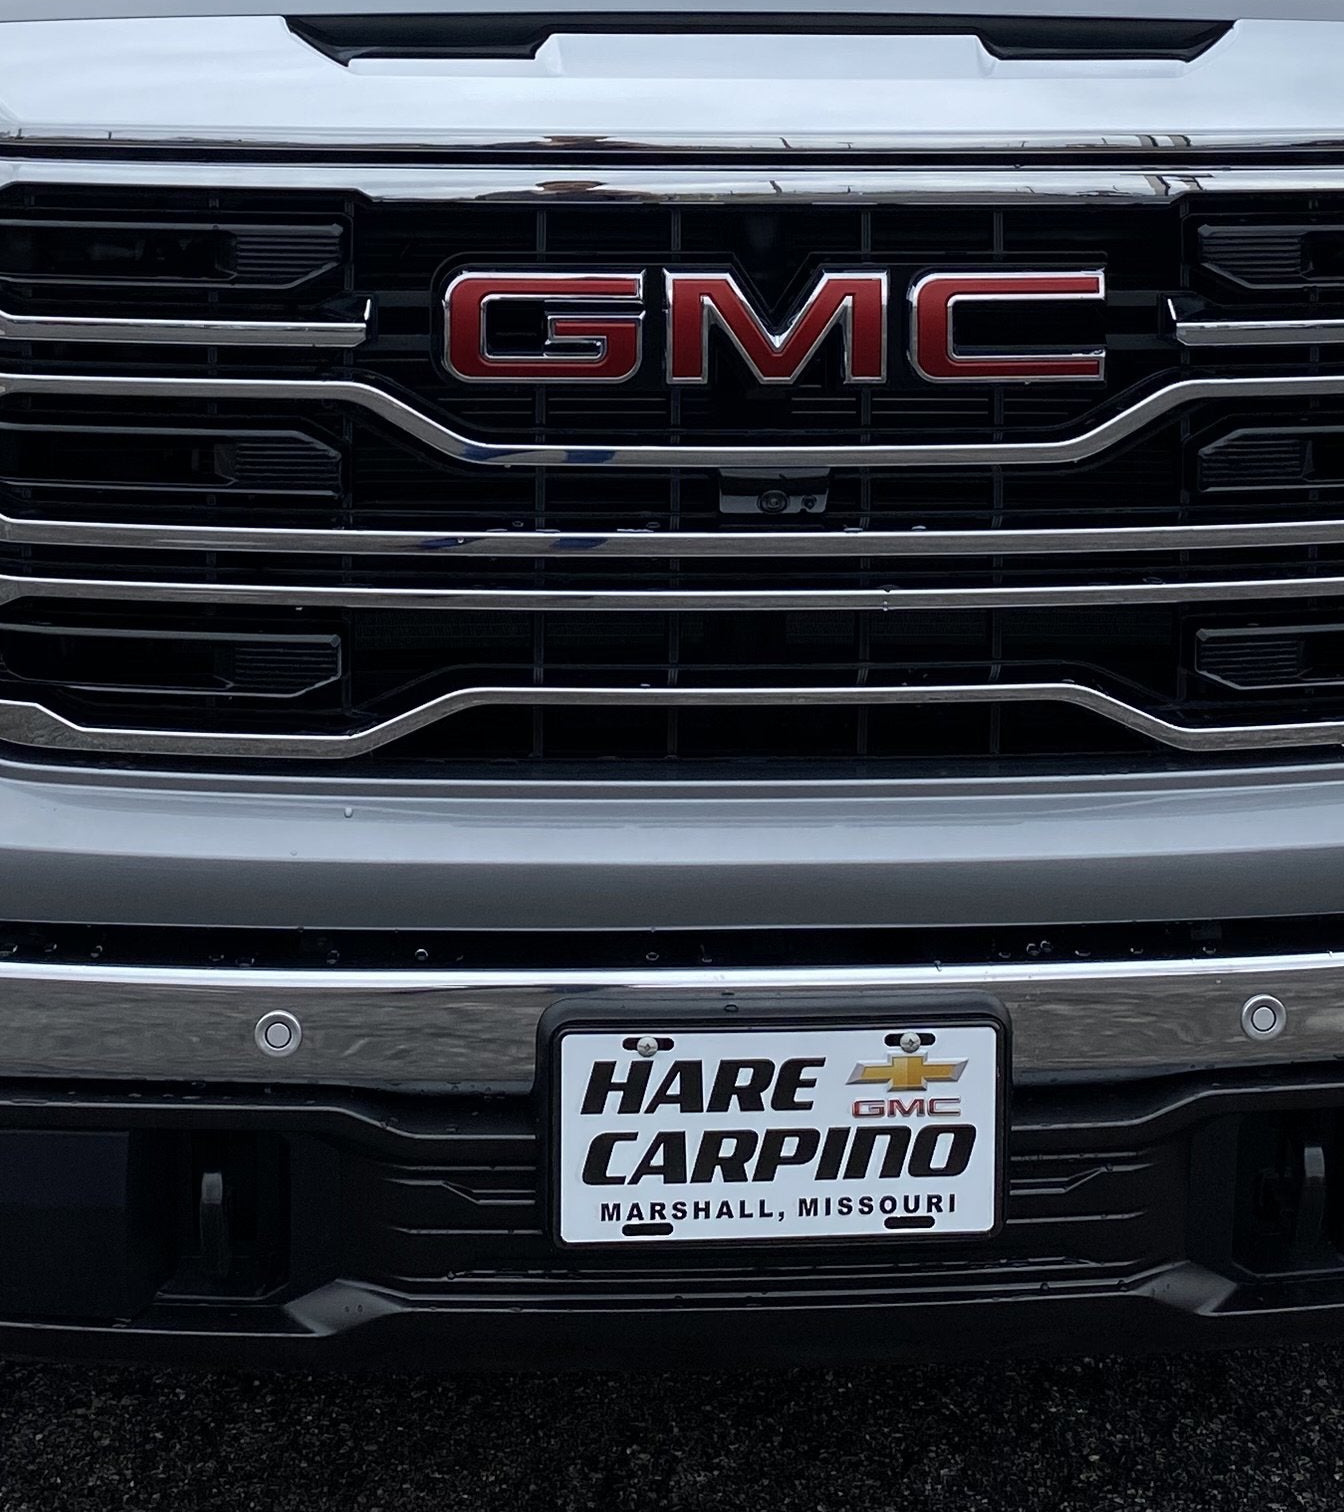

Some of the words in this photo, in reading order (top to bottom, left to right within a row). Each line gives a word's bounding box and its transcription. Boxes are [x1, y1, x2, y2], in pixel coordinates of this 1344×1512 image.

[442, 268, 1108, 384] GMC
[580, 1056, 826, 1115] HARE
[851, 1097, 962, 1119] GMC
[582, 1123, 977, 1186] CARPINO
[600, 1199, 785, 1222] MARSHALL,
[798, 1193, 957, 1218] MISSOURI
